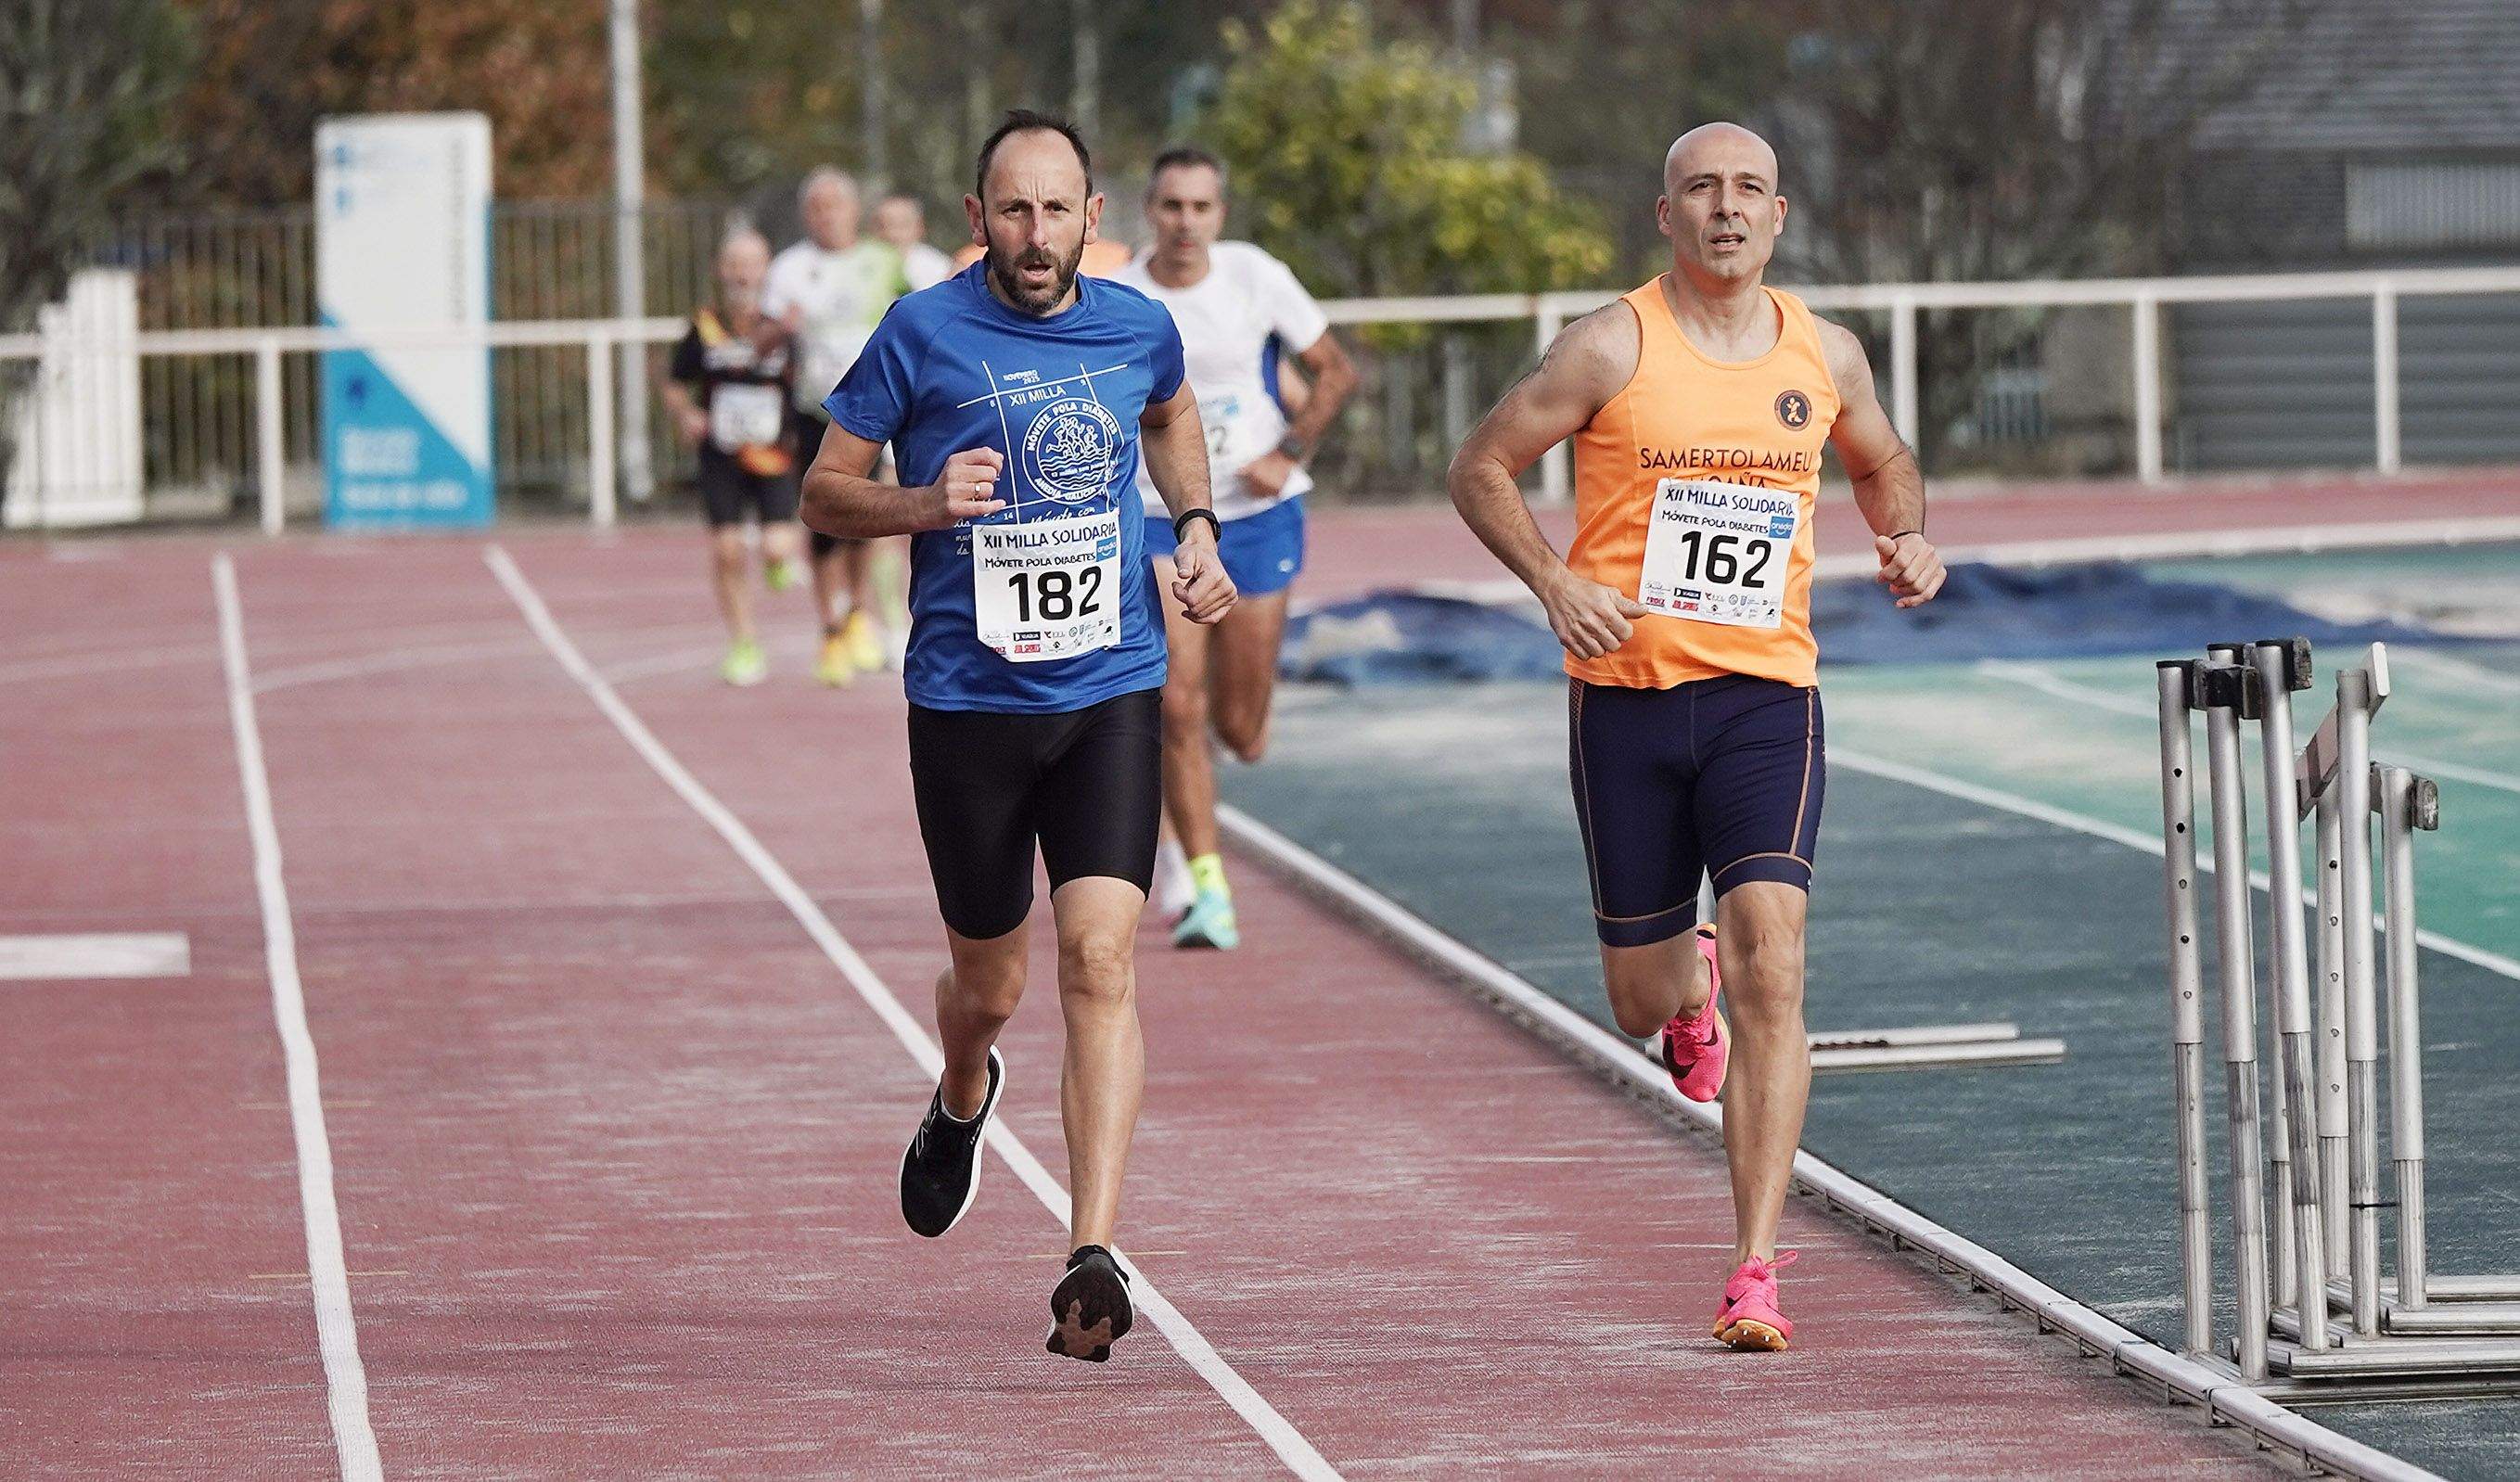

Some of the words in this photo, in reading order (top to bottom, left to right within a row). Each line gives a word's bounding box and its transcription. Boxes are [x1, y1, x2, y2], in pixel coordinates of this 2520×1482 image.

[1008, 392, 1028, 407] XII
[1029, 385, 1067, 403] MILLA
[1052, 402, 1077, 416] POLA
[1640, 447, 1812, 472] SAMERTOLAMEU
[1665, 488, 1683, 502] XII
[1687, 489, 1728, 507] MILLA
[1732, 494, 1795, 516] SOLIDARIA
[1662, 510, 1699, 525] MÓVETE
[1701, 517, 1726, 529] POLA
[1729, 520, 1769, 534] DIABETES
[983, 534, 1003, 549] XII
[1005, 531, 1049, 549] MILLA
[1052, 521, 1117, 545] SOLIDARIA
[985, 556, 1024, 569] MÓVETE
[1026, 557, 1053, 568] POLA
[1055, 553, 1096, 565] DIABETES
[1681, 530, 1772, 589] 162
[1008, 566, 1102, 622] 182
